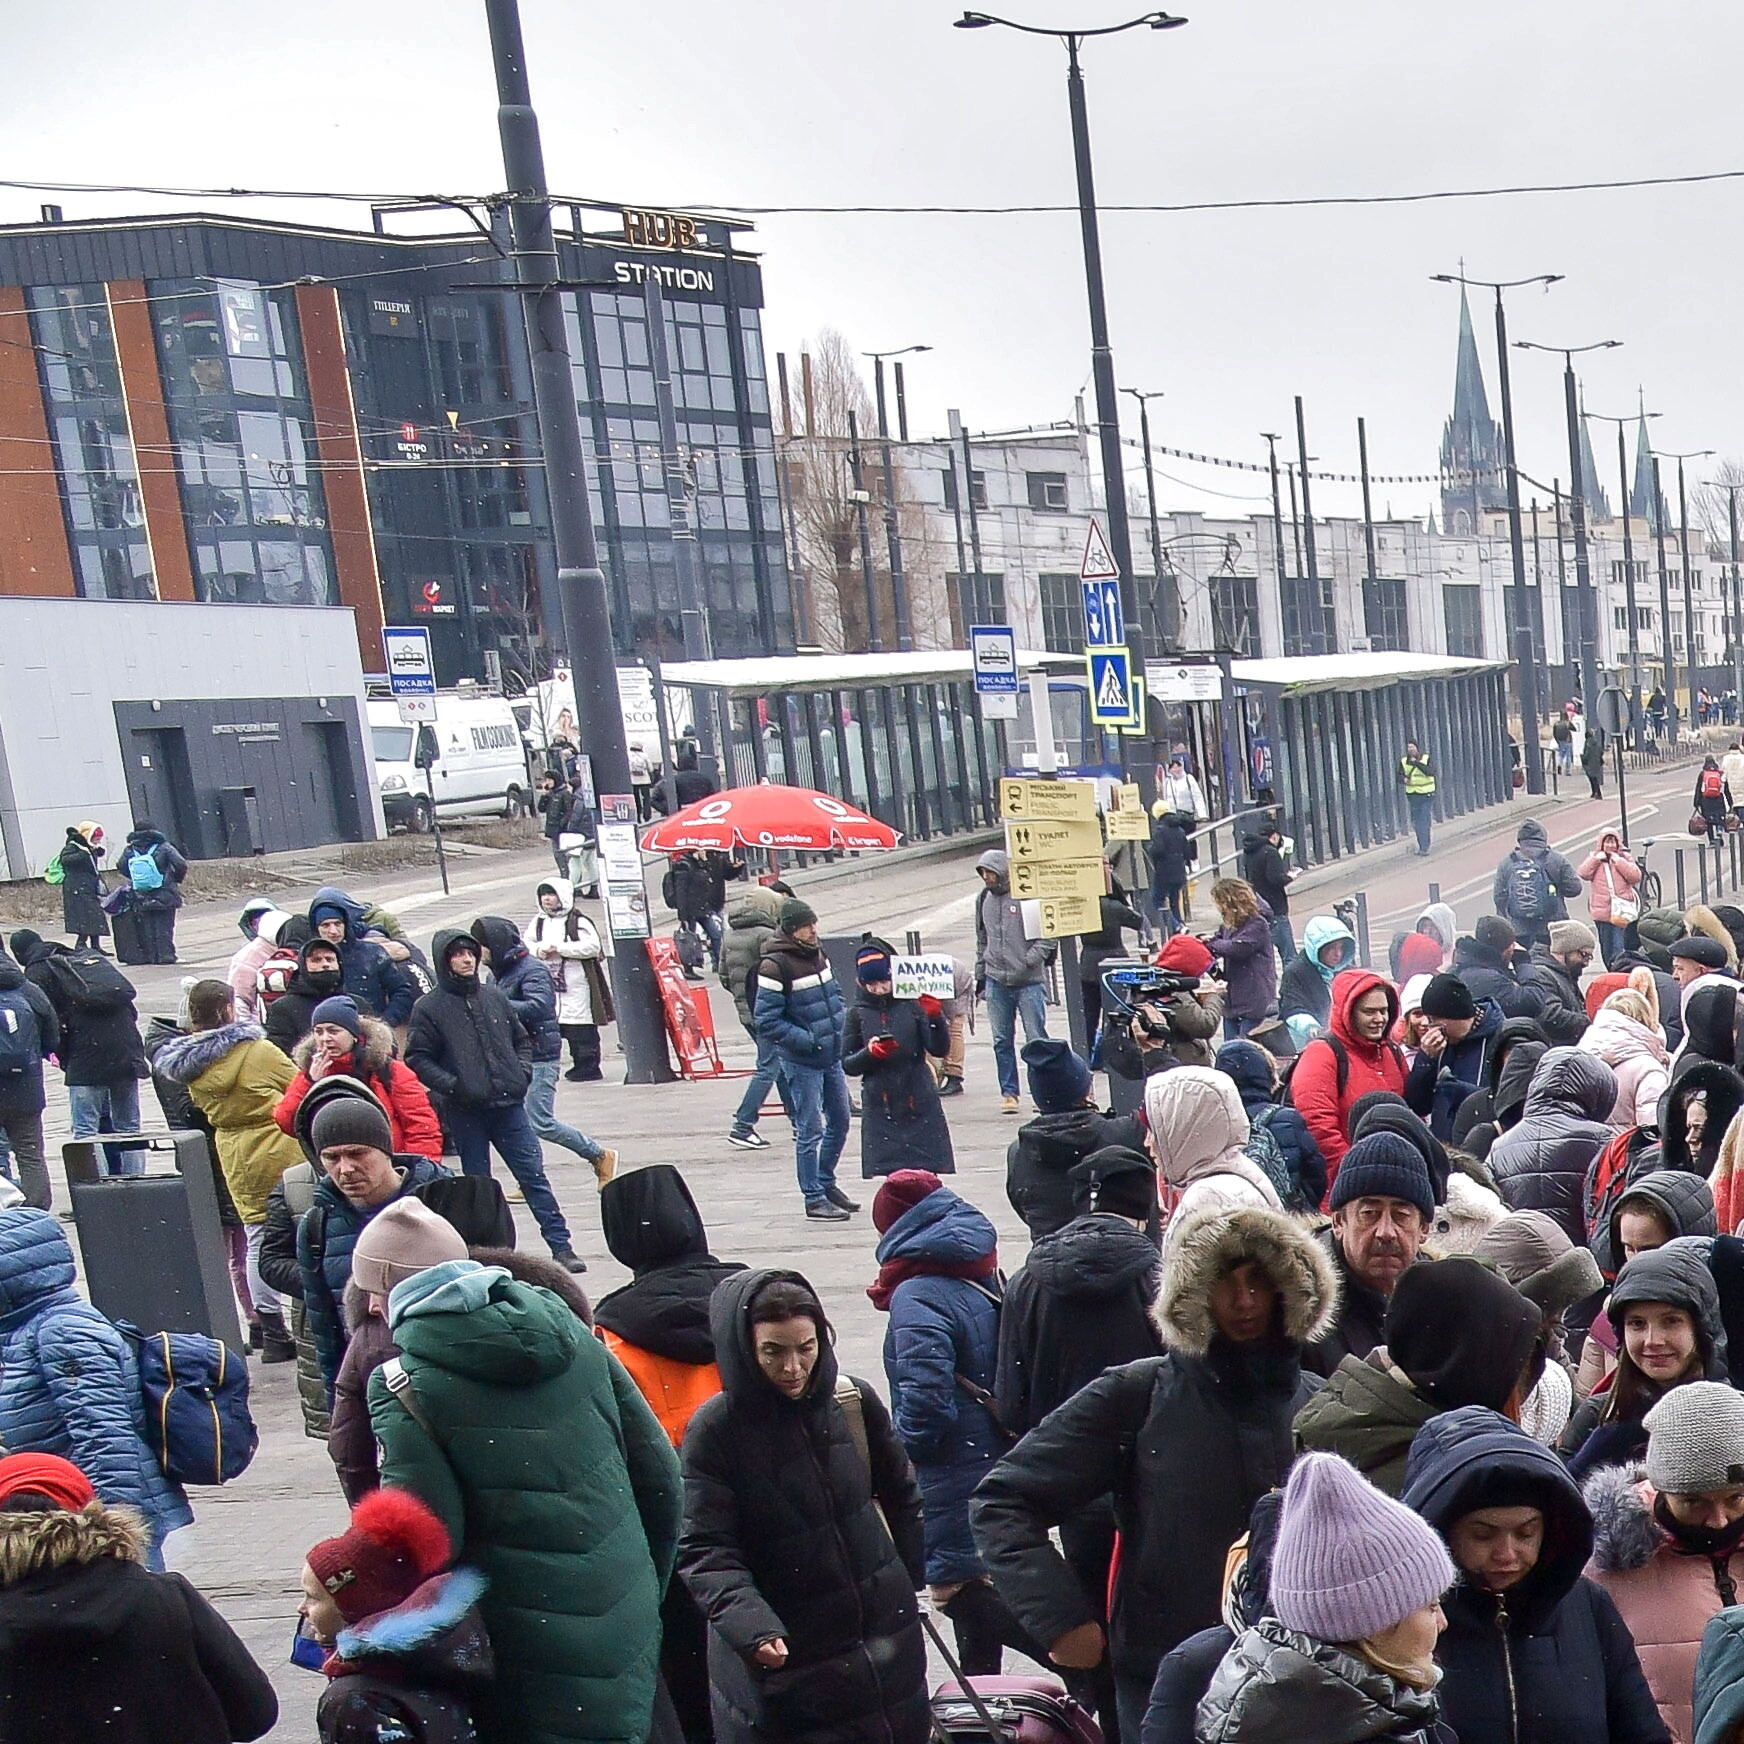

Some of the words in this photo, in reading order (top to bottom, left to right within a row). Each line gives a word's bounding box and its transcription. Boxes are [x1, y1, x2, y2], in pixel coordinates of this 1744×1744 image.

[622, 210, 697, 248] HUB
[393, 679, 433, 688] ПОСАДКА
[624, 711, 658, 724] SCO
[774, 835, 813, 844] vodafone
[1038, 831, 1069, 840] ТУАЛЕТ
